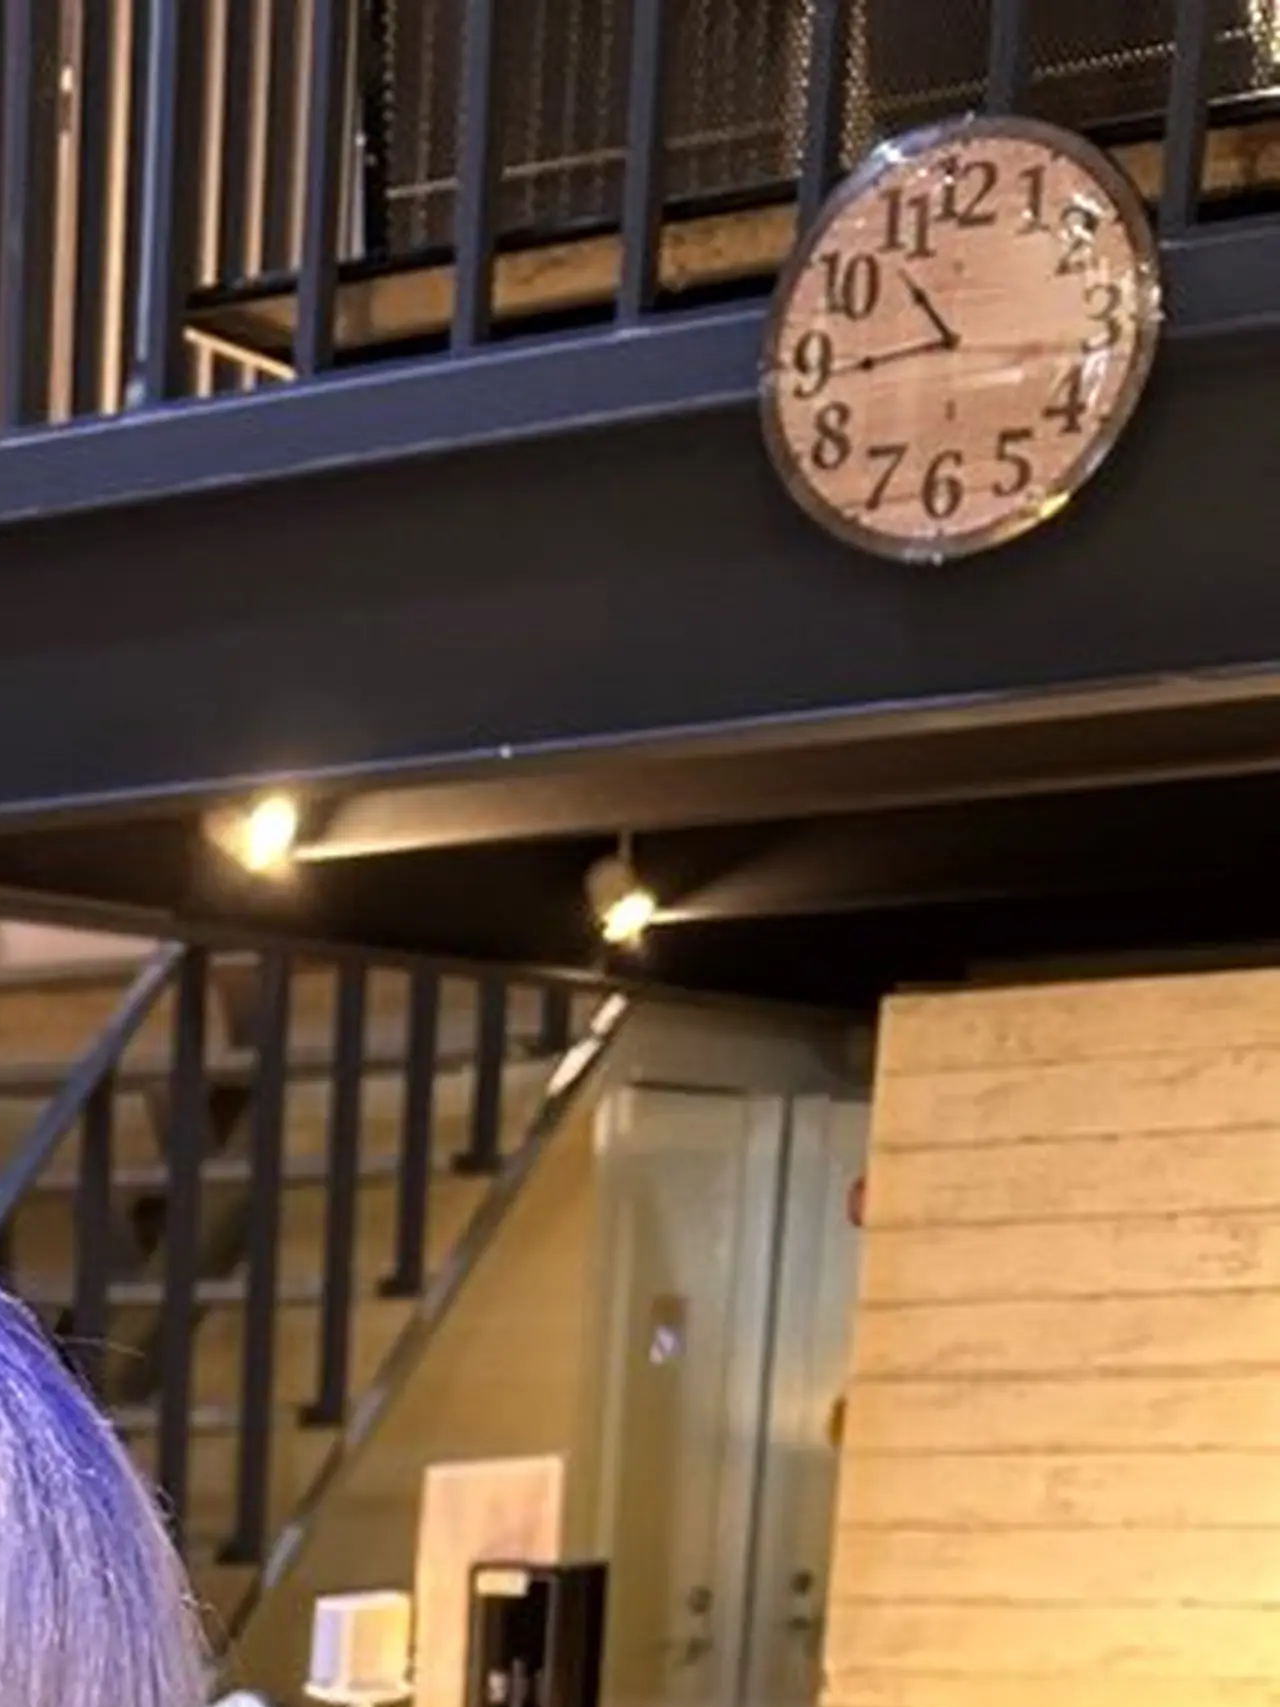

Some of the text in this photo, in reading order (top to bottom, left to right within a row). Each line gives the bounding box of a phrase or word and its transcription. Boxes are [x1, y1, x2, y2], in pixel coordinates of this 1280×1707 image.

[877, 188, 935, 260] 11
[937, 158, 998, 226] 12
[1017, 165, 1050, 235] 1
[1055, 203, 1100, 276] 2
[819, 252, 880, 322] 10
[1083, 283, 1123, 353] 3
[793, 330, 833, 400] 9
[1042, 364, 1088, 433] 4
[811, 402, 853, 471] 8
[993, 428, 1035, 496] 5
[865, 445, 910, 511] 7
[921, 450, 965, 520] 6
